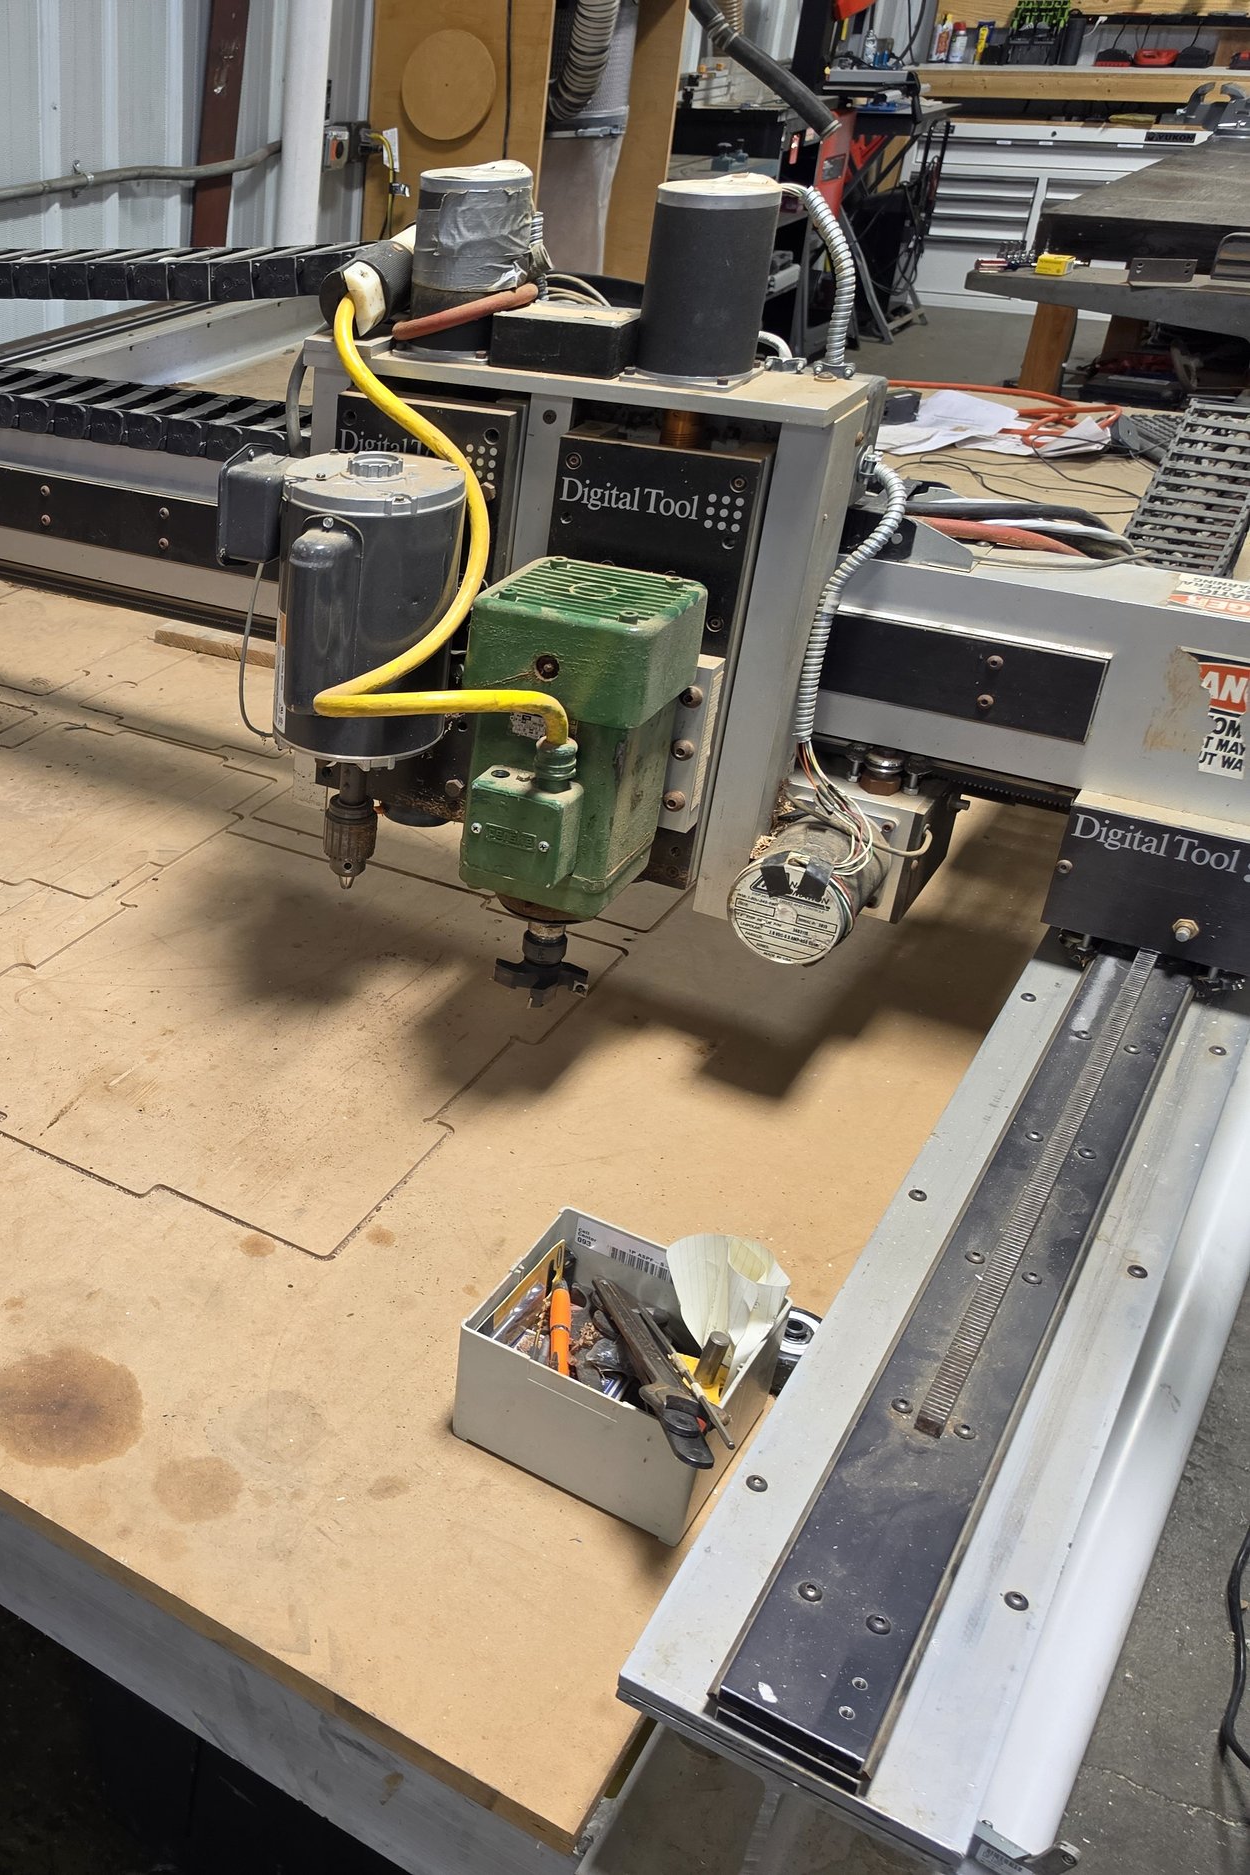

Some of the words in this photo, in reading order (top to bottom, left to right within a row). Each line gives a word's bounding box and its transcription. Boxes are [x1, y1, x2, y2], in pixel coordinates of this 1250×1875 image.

[1158, 133, 1195, 143] YUKON
[340, 428, 409, 453] Digital
[559, 476, 641, 512] Digital
[643, 487, 700, 521] Tool
[1200, 670, 1249, 705] AN
[1070, 813, 1167, 857] Digital
[1173, 836, 1241, 874] Tool
